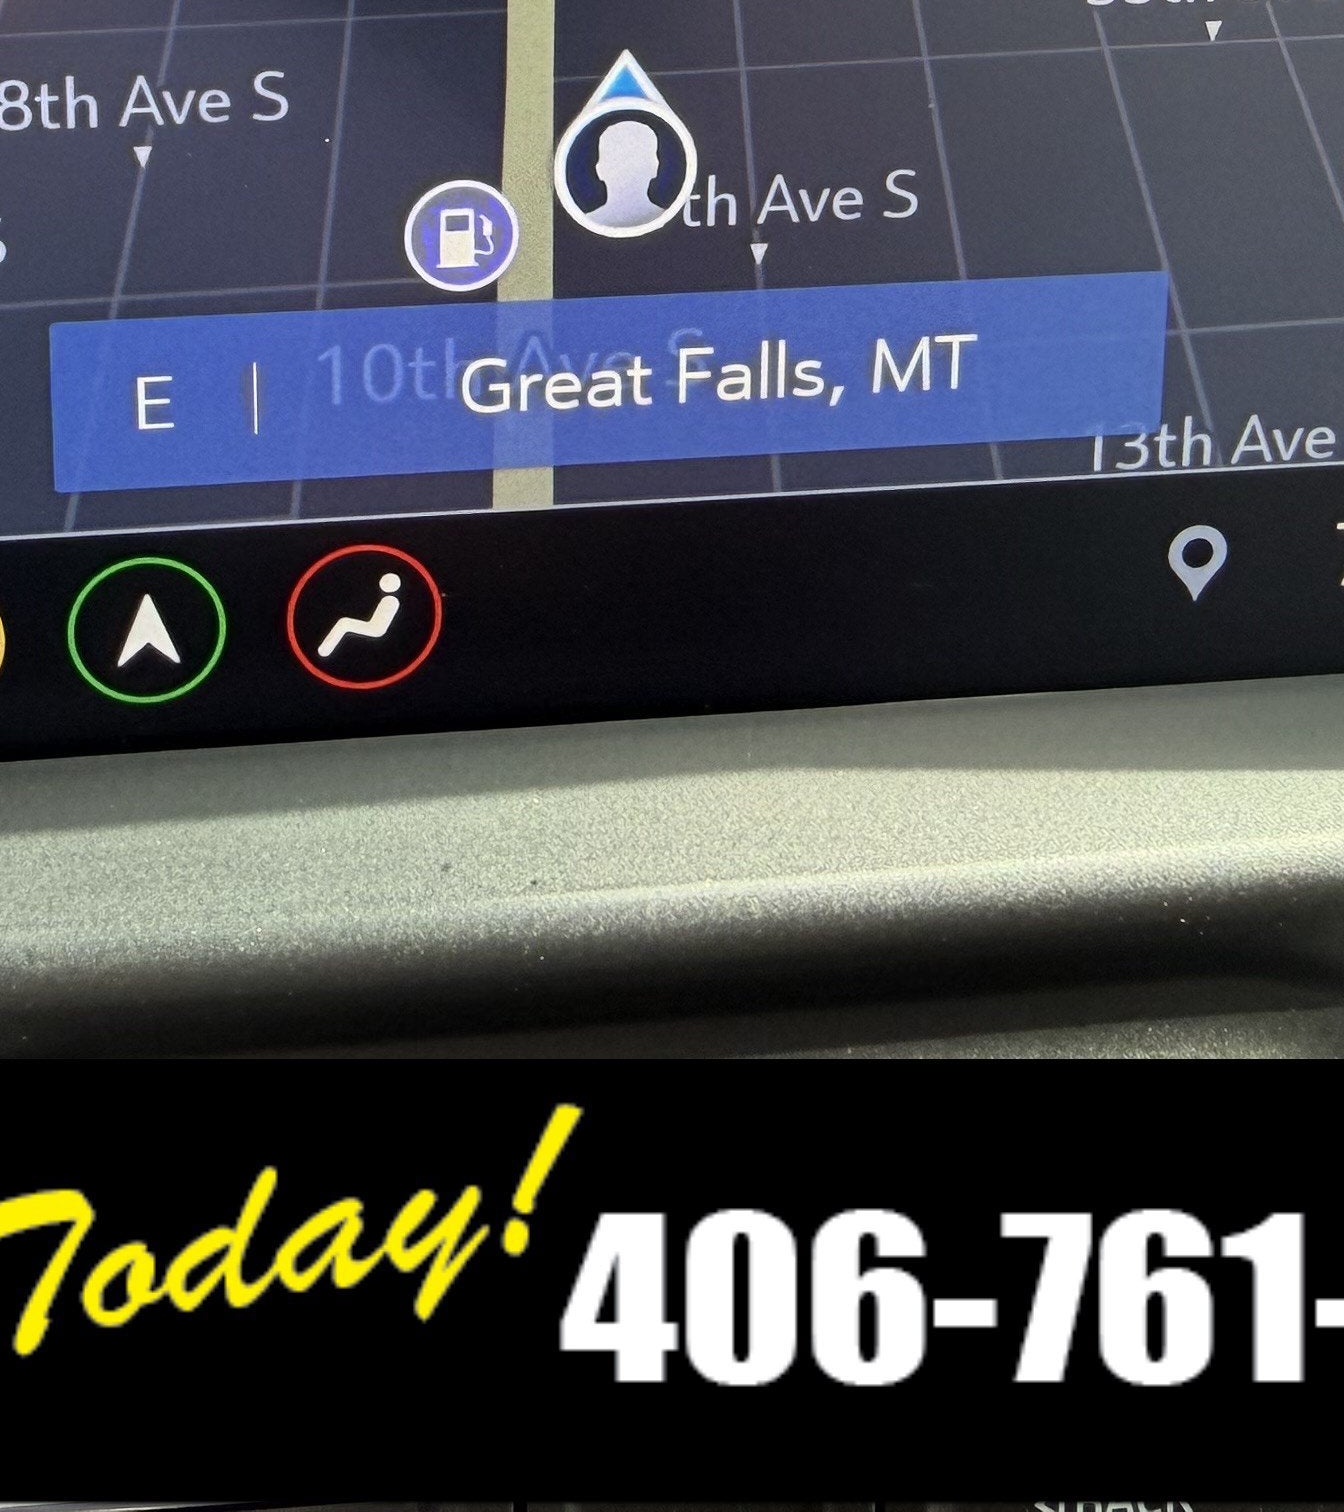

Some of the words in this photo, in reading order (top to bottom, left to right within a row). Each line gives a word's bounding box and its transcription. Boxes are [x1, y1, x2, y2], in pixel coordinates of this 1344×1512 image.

[118, 75, 231, 127] Ave
[252, 70, 289, 122] S
[683, 175, 738, 227] th
[756, 173, 864, 225] Ave
[883, 169, 919, 219] S
[136, 375, 175, 430] E
[461, 355, 653, 414] Great
[678, 339, 845, 407] Falls,
[872, 333, 978, 394] MT
[1093, 414, 1212, 472] 13th
[1230, 414, 1337, 464] Ave
